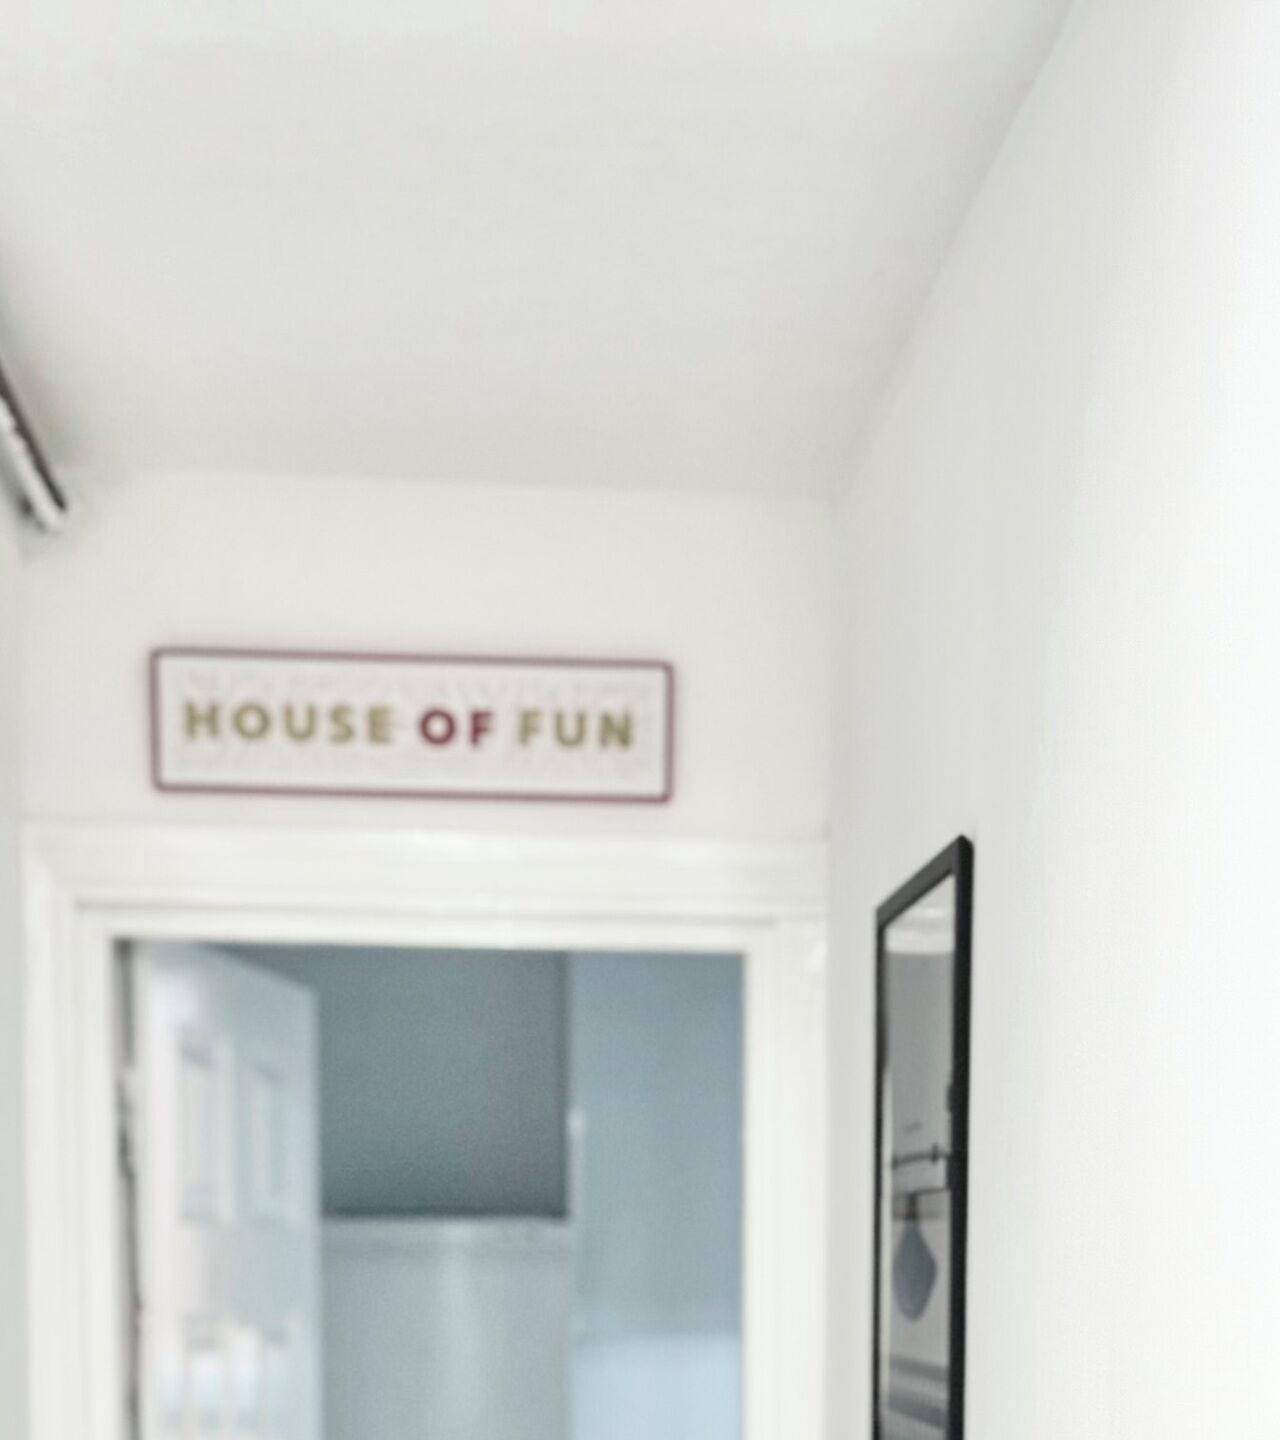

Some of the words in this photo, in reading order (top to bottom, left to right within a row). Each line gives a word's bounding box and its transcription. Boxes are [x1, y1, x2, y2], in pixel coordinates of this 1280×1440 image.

[183, 700, 394, 745] HOUSE
[417, 707, 495, 748] OF
[518, 709, 635, 749] FUN
